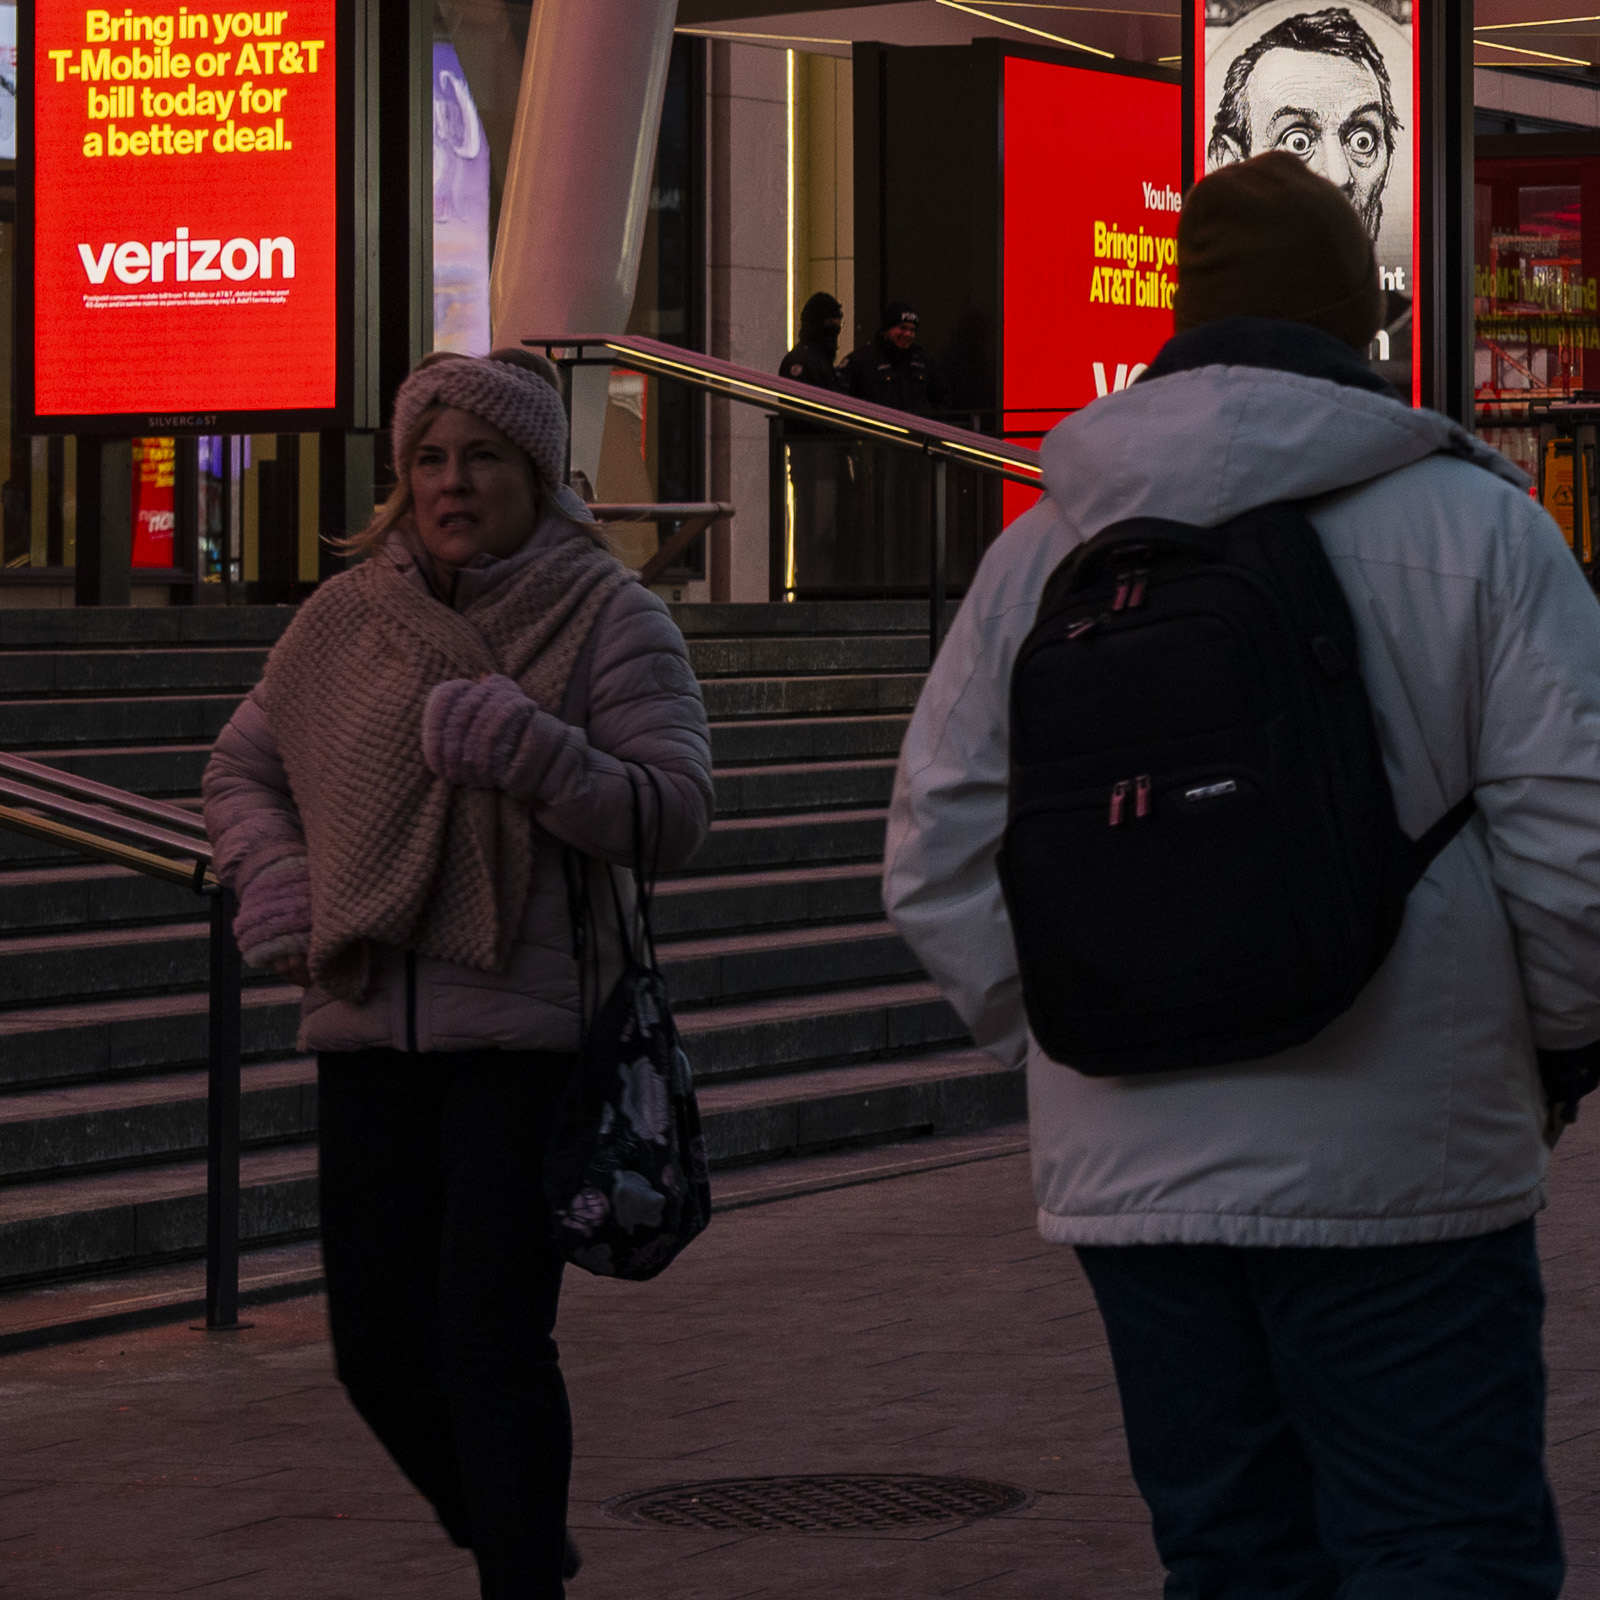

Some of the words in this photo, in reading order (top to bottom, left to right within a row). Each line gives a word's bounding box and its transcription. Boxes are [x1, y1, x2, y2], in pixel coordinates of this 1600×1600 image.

[86, 8, 174, 47] Bring
[179, 6, 208, 39] in
[212, 10, 288, 45] your
[48, 46, 191, 82] T-Mobile
[195, 52, 231, 77] or
[235, 40, 325, 76] AT&T
[88, 85, 135, 120] bill
[141, 83, 235, 122] today
[239, 81, 288, 114] for
[83, 131, 103, 158] a
[107, 123, 209, 157] better
[212, 118, 293, 153] deal.
[1142, 181, 1165, 209] You
[78, 227, 295, 285] verizon
[1094, 219, 1138, 269] Bring
[1139, 224, 1154, 261] in
[1090, 266, 1133, 306] AT&T
[1135, 270, 1159, 308] bill
[1160, 272, 1178, 310] fo
